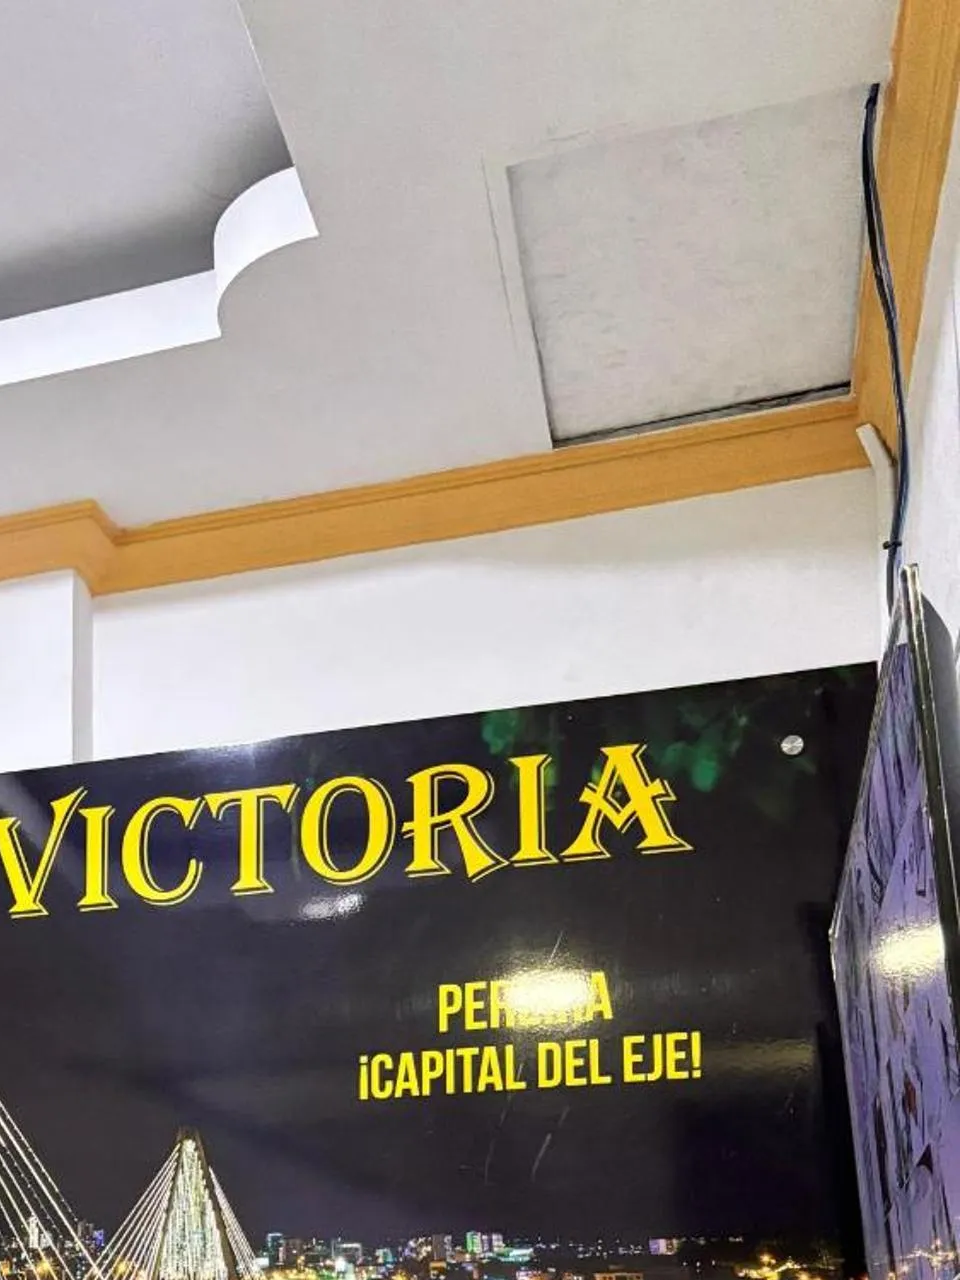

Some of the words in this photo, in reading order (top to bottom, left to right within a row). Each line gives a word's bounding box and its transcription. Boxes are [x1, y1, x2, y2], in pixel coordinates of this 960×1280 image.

[438, 971, 613, 1033] PERA
[359, 1044, 526, 1101] ¡CAPITAL
[538, 1039, 612, 1088] DEL
[623, 1031, 702, 1083] EJE!
